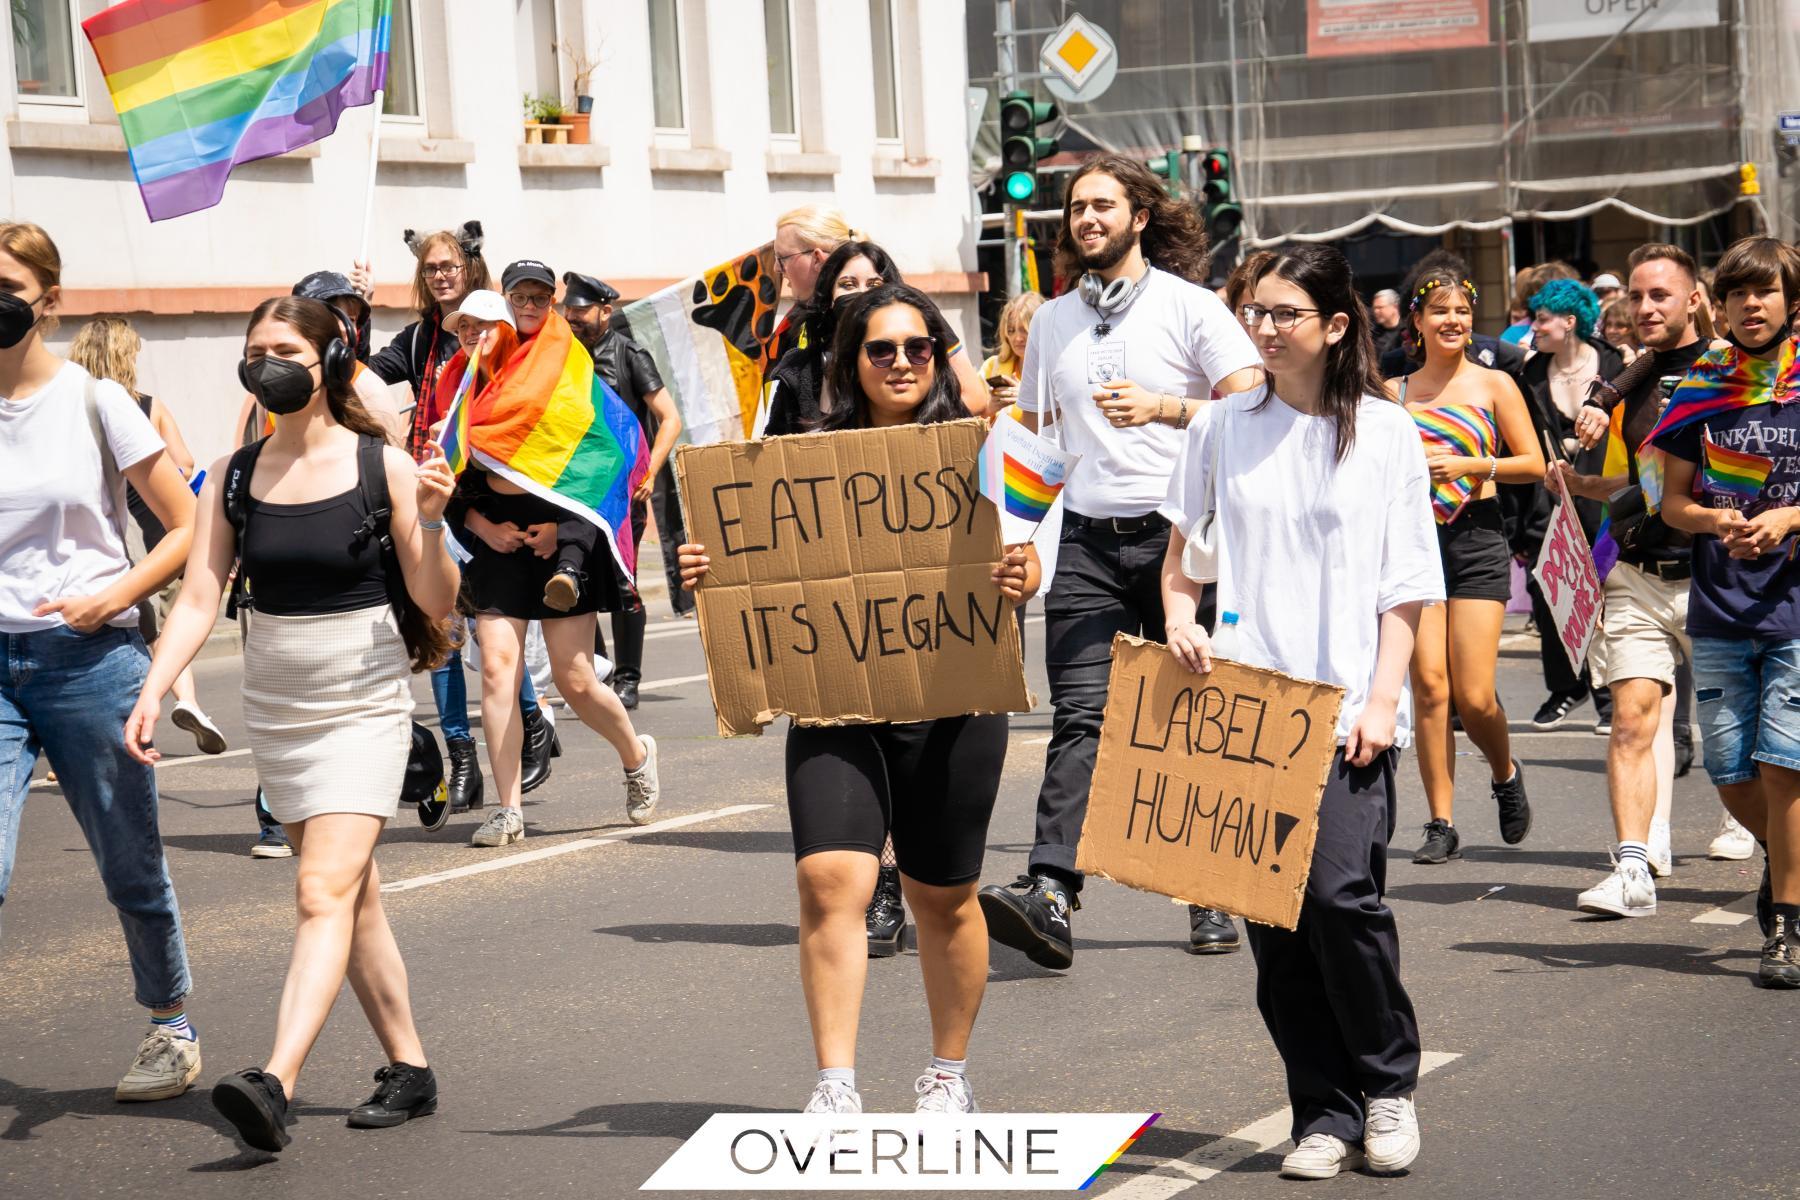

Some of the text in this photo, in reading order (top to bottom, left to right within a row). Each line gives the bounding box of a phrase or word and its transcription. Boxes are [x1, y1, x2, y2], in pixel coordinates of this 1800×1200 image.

[712, 466, 980, 556] EAT PUSSY
[740, 590, 1003, 670] IT'S VEGAN
[1130, 676, 1311, 771] LABEL?
[1126, 768, 1300, 873] HUMAN!
